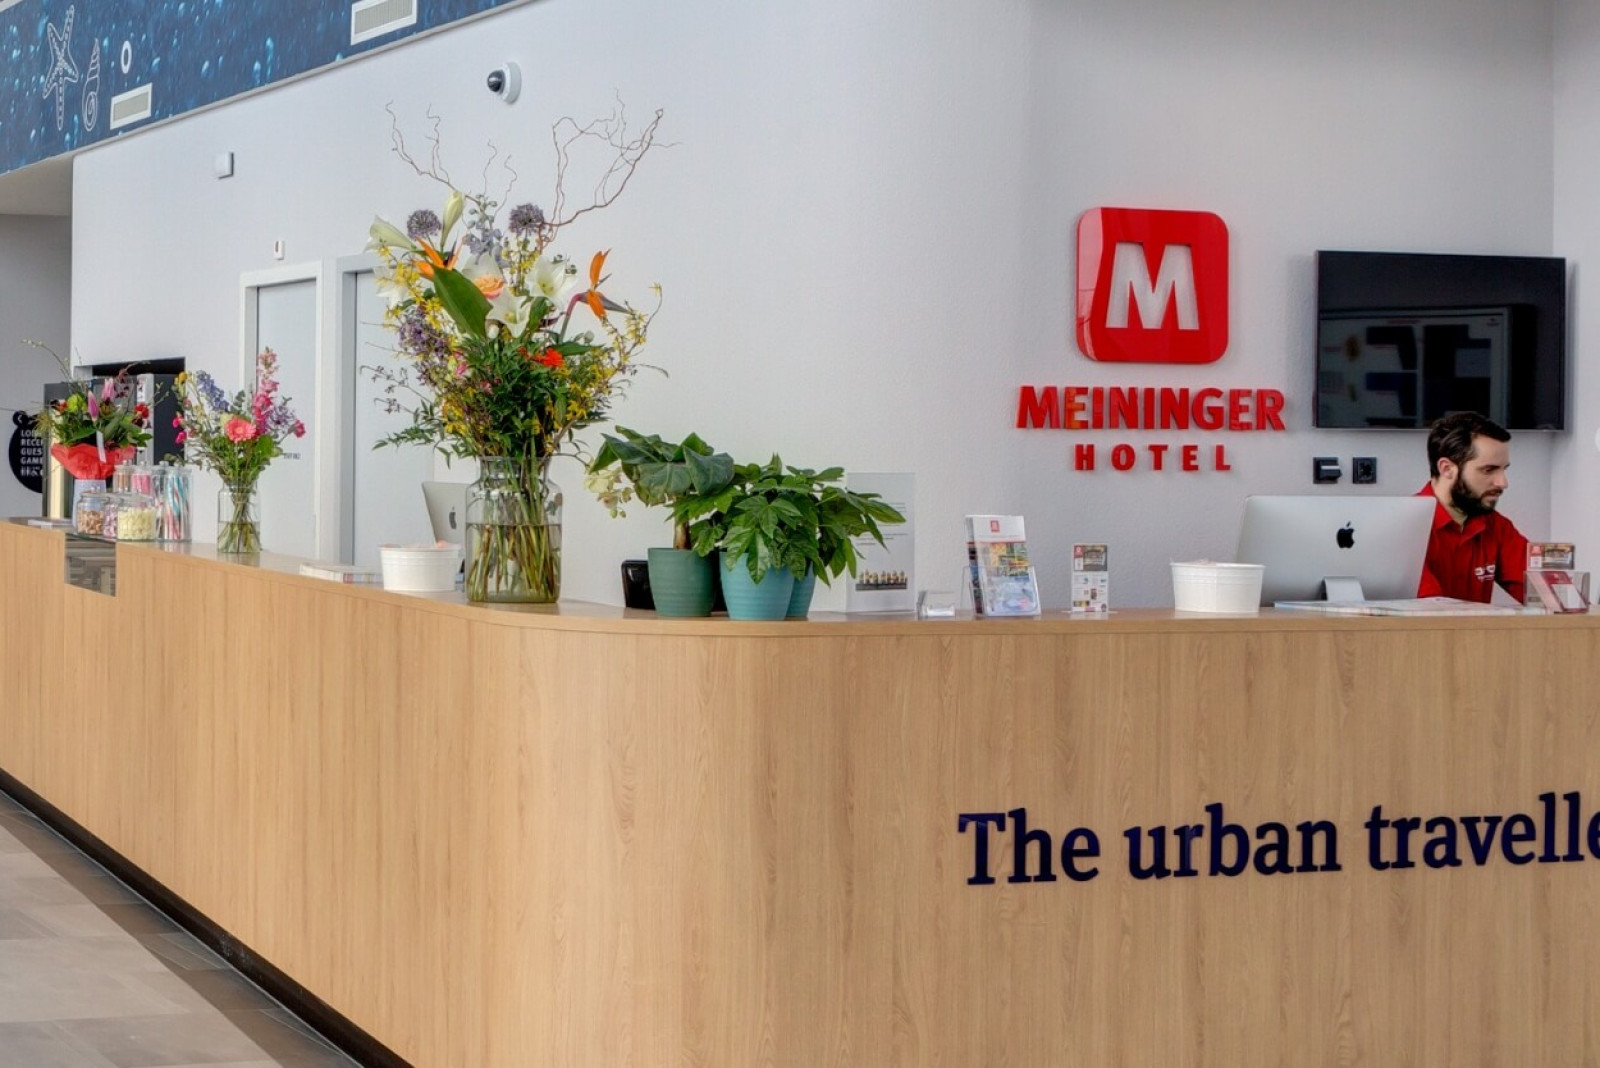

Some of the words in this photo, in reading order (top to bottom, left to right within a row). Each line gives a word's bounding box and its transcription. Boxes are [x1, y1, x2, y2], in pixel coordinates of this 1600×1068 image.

[1105, 240, 1200, 331] M
[1015, 384, 1286, 432] MEININGER
[1074, 442, 1231, 473] HOTEL
[958, 808, 1101, 886] The
[1123, 802, 1342, 880] urban
